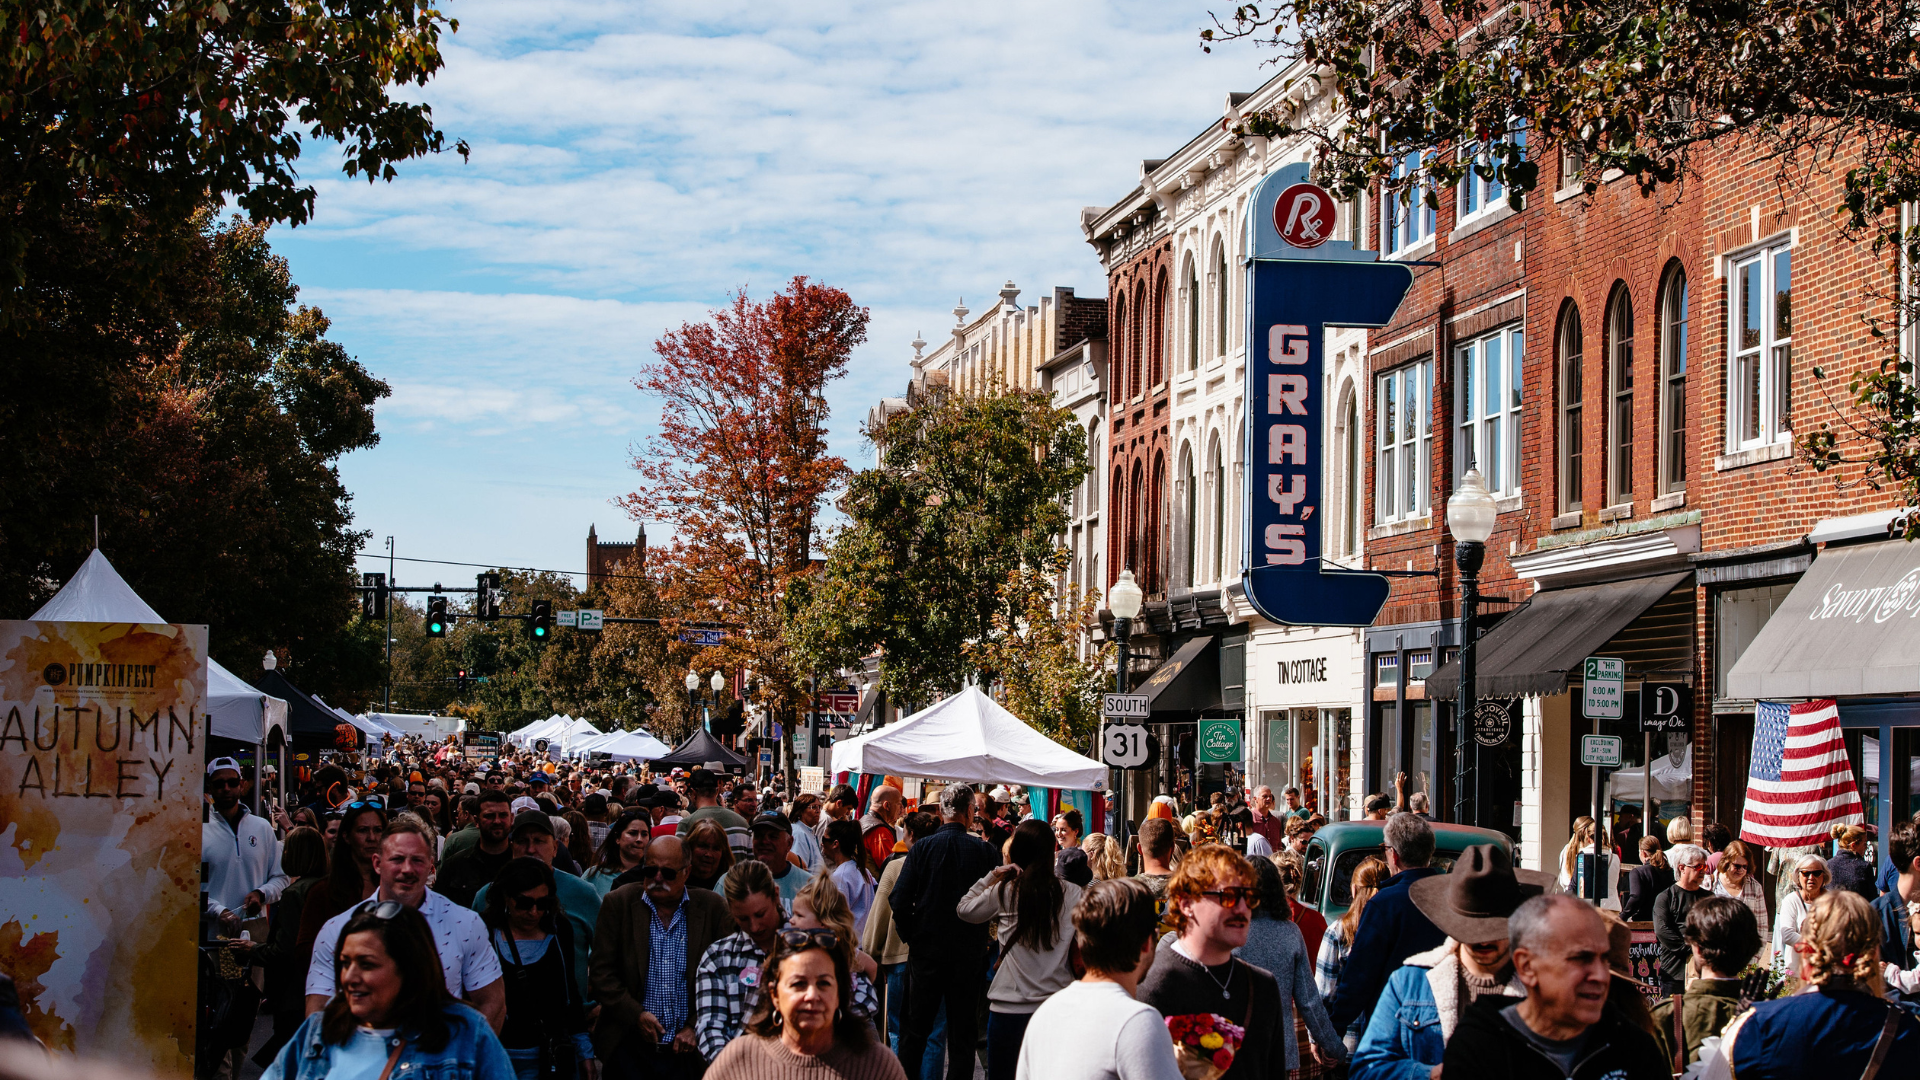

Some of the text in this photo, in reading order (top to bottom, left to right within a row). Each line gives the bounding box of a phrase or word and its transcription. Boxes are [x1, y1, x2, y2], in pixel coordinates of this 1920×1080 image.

[1264, 324, 1315, 566] GRAY'S
[1809, 583, 1893, 624] Savory
[69, 663, 156, 688] PUMPKINFEST
[1277, 657, 1327, 685] TIN COTTAGE
[1587, 662, 1596, 677] 2
[1597, 671, 1622, 679] PARKING
[1592, 687, 1616, 695] 8:00 AM
[1107, 698, 1147, 712] SOUTH
[1588, 699, 1619, 708] TO 5:00 PM
[1474, 707, 1484, 719] BE
[1484, 704, 1508, 727] JOYFUL
[1643, 715, 1686, 732] imago Dei
[0, 705, 194, 754] AUTUMN
[1213, 731, 1226, 741] Tin
[1112, 733, 1138, 757] 31
[1206, 738, 1233, 750] Cottage
[19, 754, 174, 800] ALLEY
